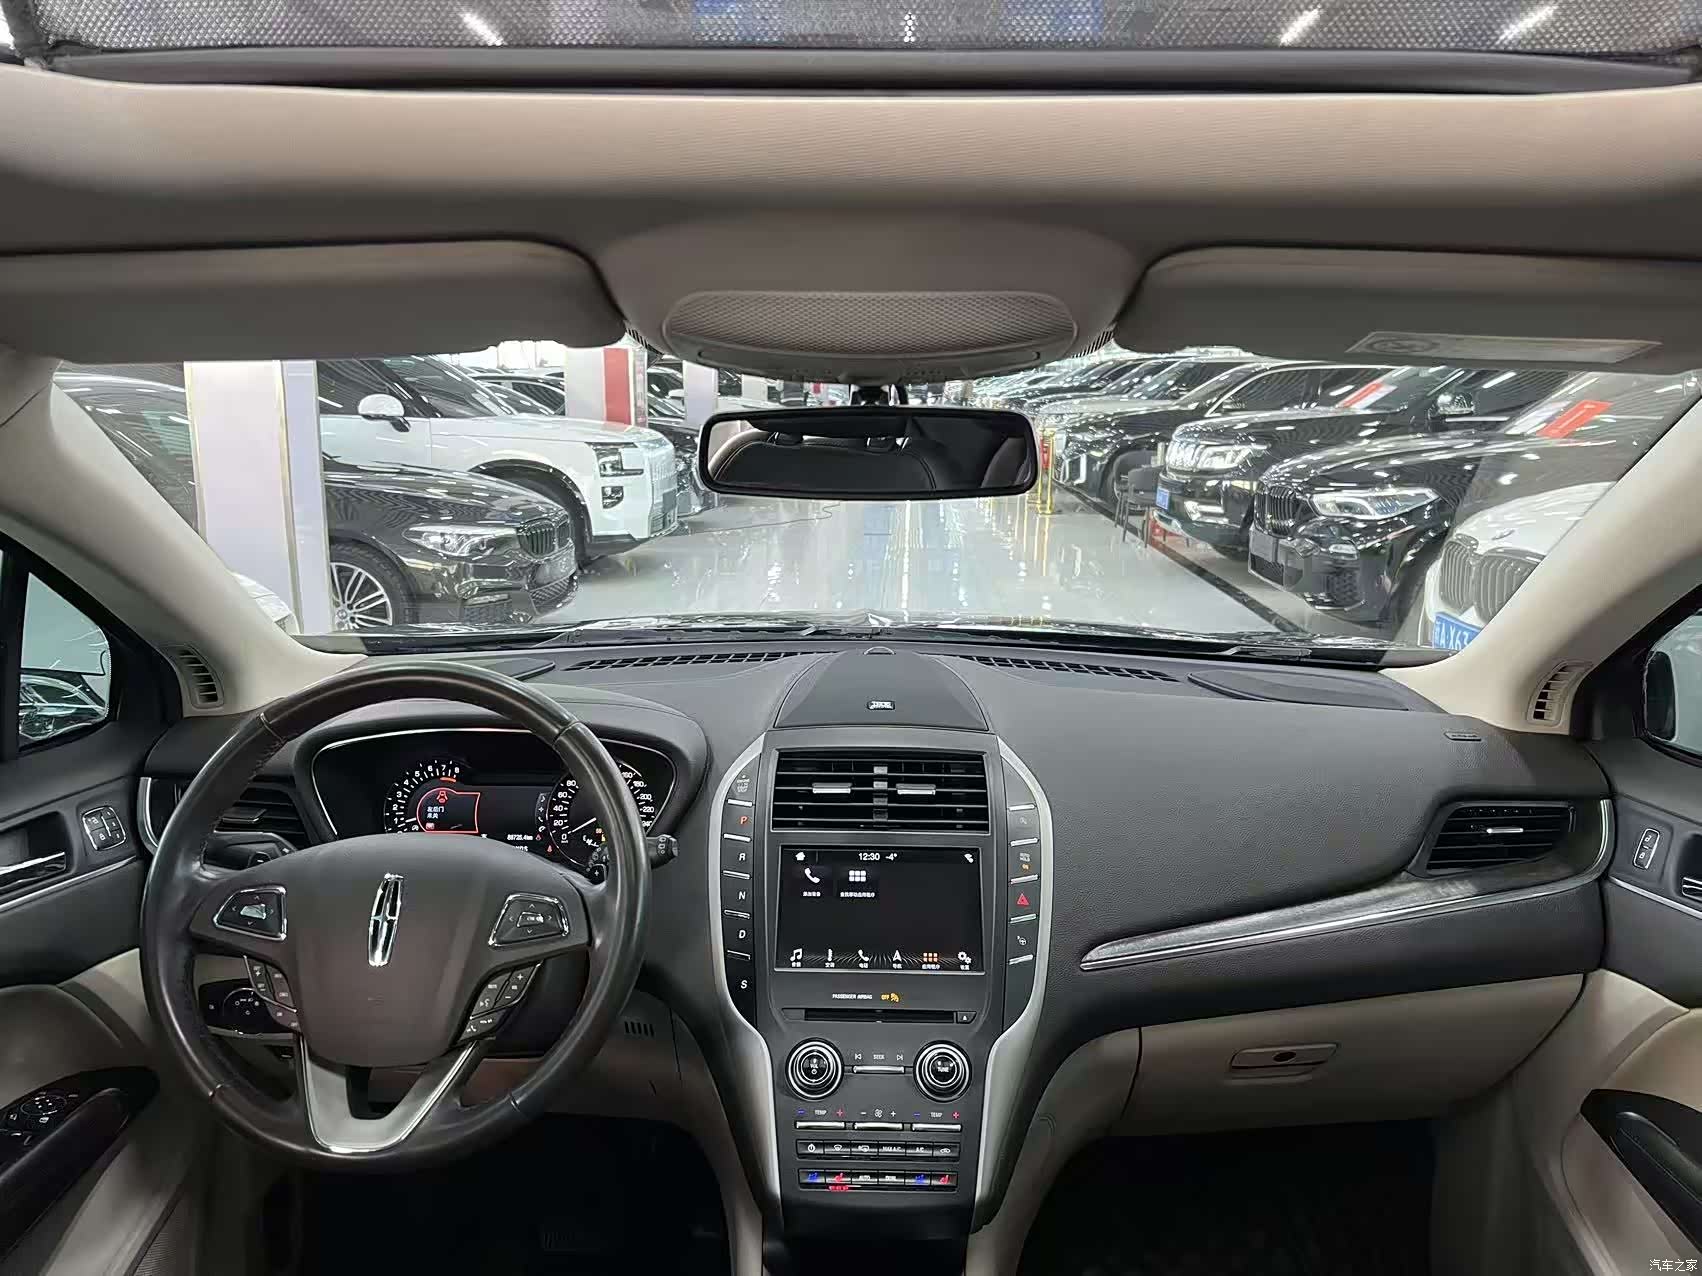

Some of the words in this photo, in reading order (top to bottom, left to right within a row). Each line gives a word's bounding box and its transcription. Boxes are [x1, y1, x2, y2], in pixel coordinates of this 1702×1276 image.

[740, 815, 748, 824] P
[738, 853, 746, 861] R
[859, 852, 880, 861] 12:30
[738, 891, 746, 900] N
[738, 930, 746, 938] D
[740, 980, 748, 989] S
